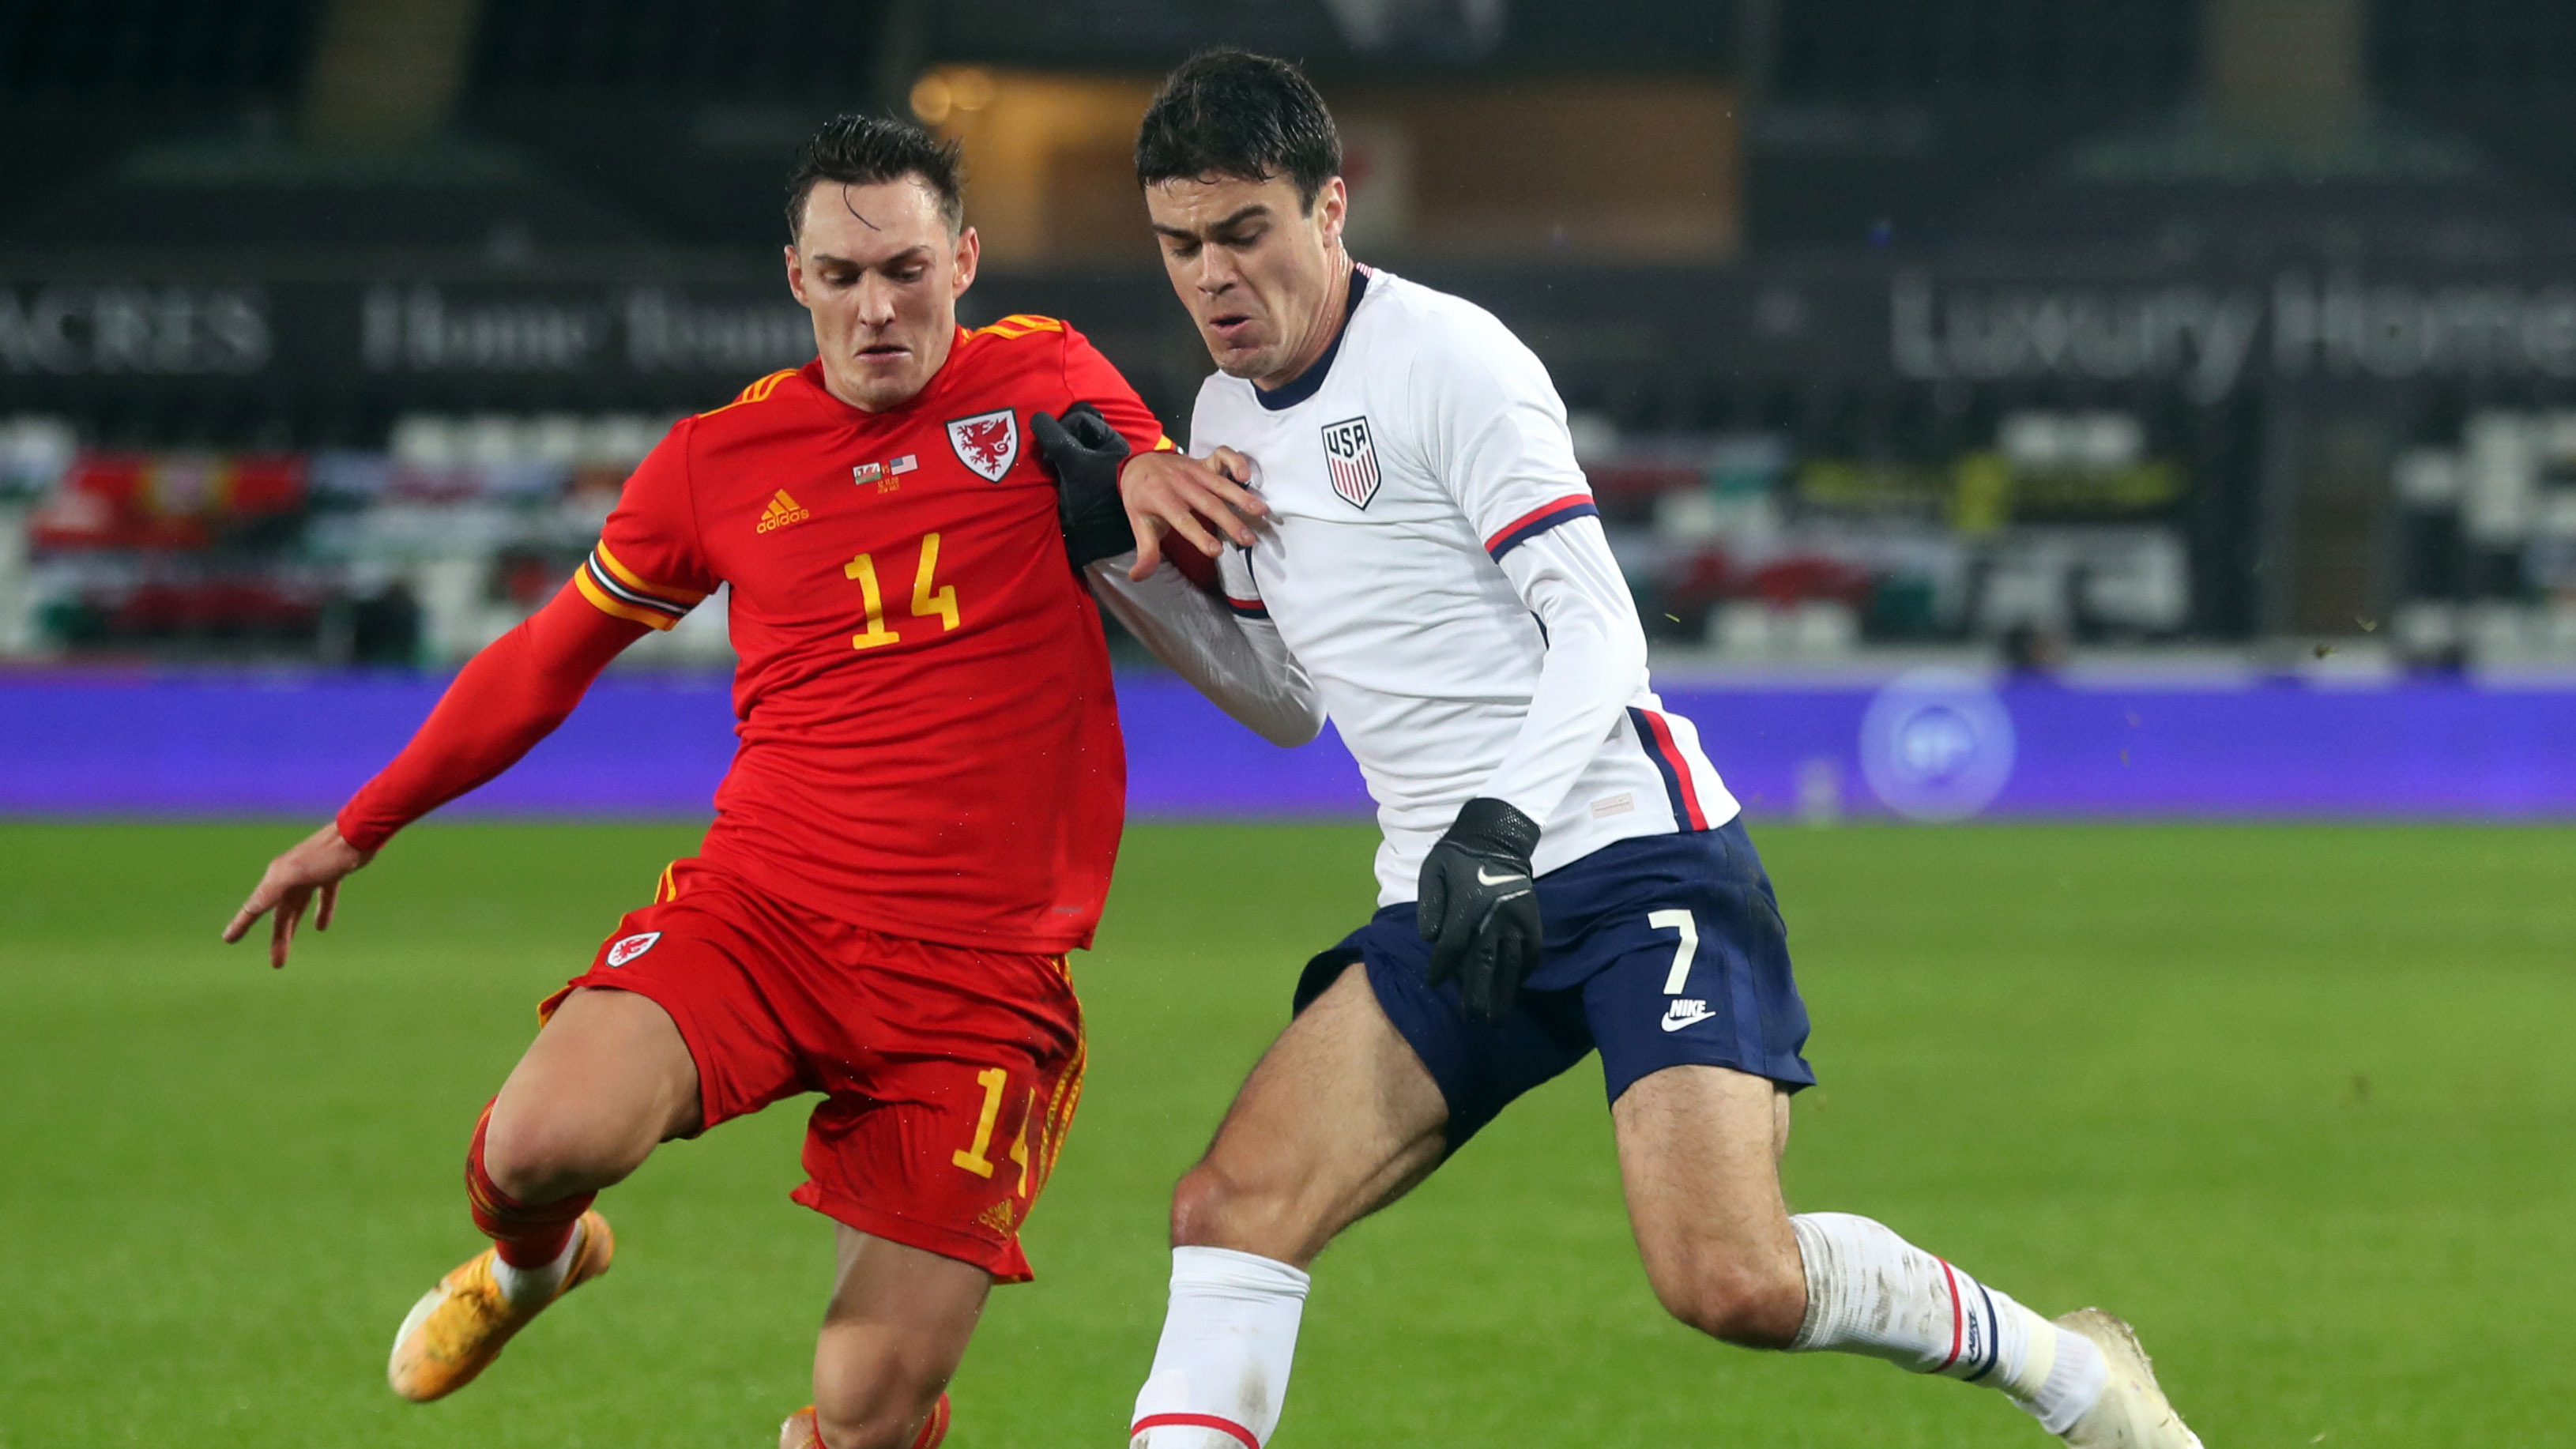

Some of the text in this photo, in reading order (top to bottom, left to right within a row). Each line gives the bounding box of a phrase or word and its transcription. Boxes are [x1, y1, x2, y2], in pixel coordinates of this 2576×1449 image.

[1891, 273, 2262, 405] Luxury
[1328, 424, 1366, 458] USA
[756, 509, 810, 534] adidas
[844, 532, 960, 649] 14
[1648, 909, 1699, 995] 7
[1669, 999, 1707, 1018] NIKE
